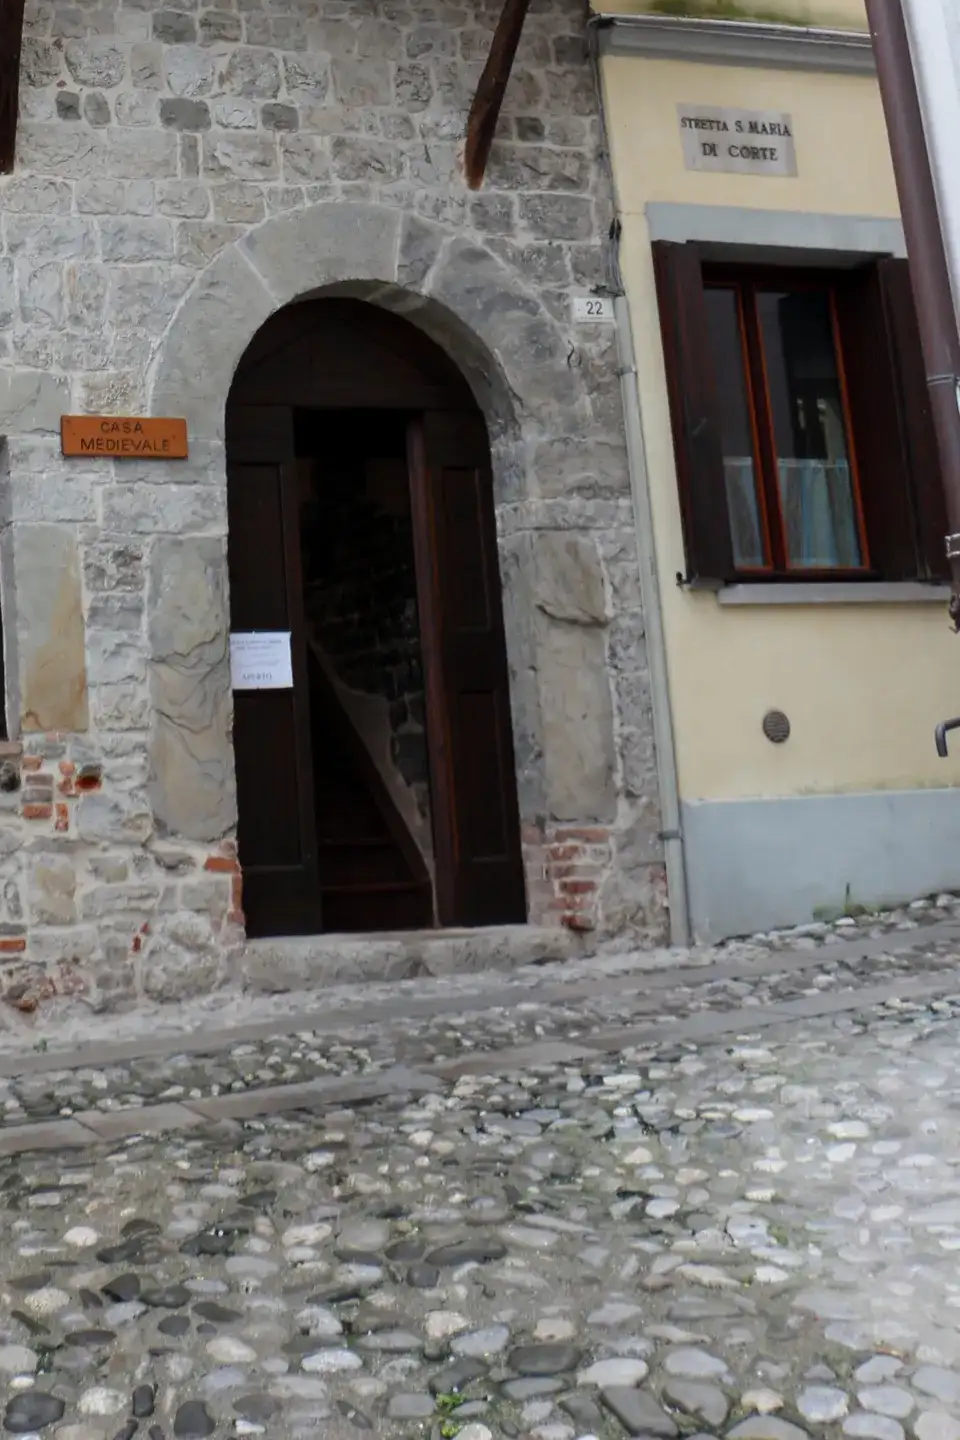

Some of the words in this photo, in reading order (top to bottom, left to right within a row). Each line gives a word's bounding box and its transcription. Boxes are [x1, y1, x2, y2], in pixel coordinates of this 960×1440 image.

[680, 117, 729, 132] STRETTA
[748, 121, 791, 137] MARIA
[701, 142, 718, 157] DI
[728, 145, 778, 161] CORTE
[586, 301, 603, 315] 22
[100, 421, 144, 434] CASA
[80, 438, 170, 452] MEDIEVALE
